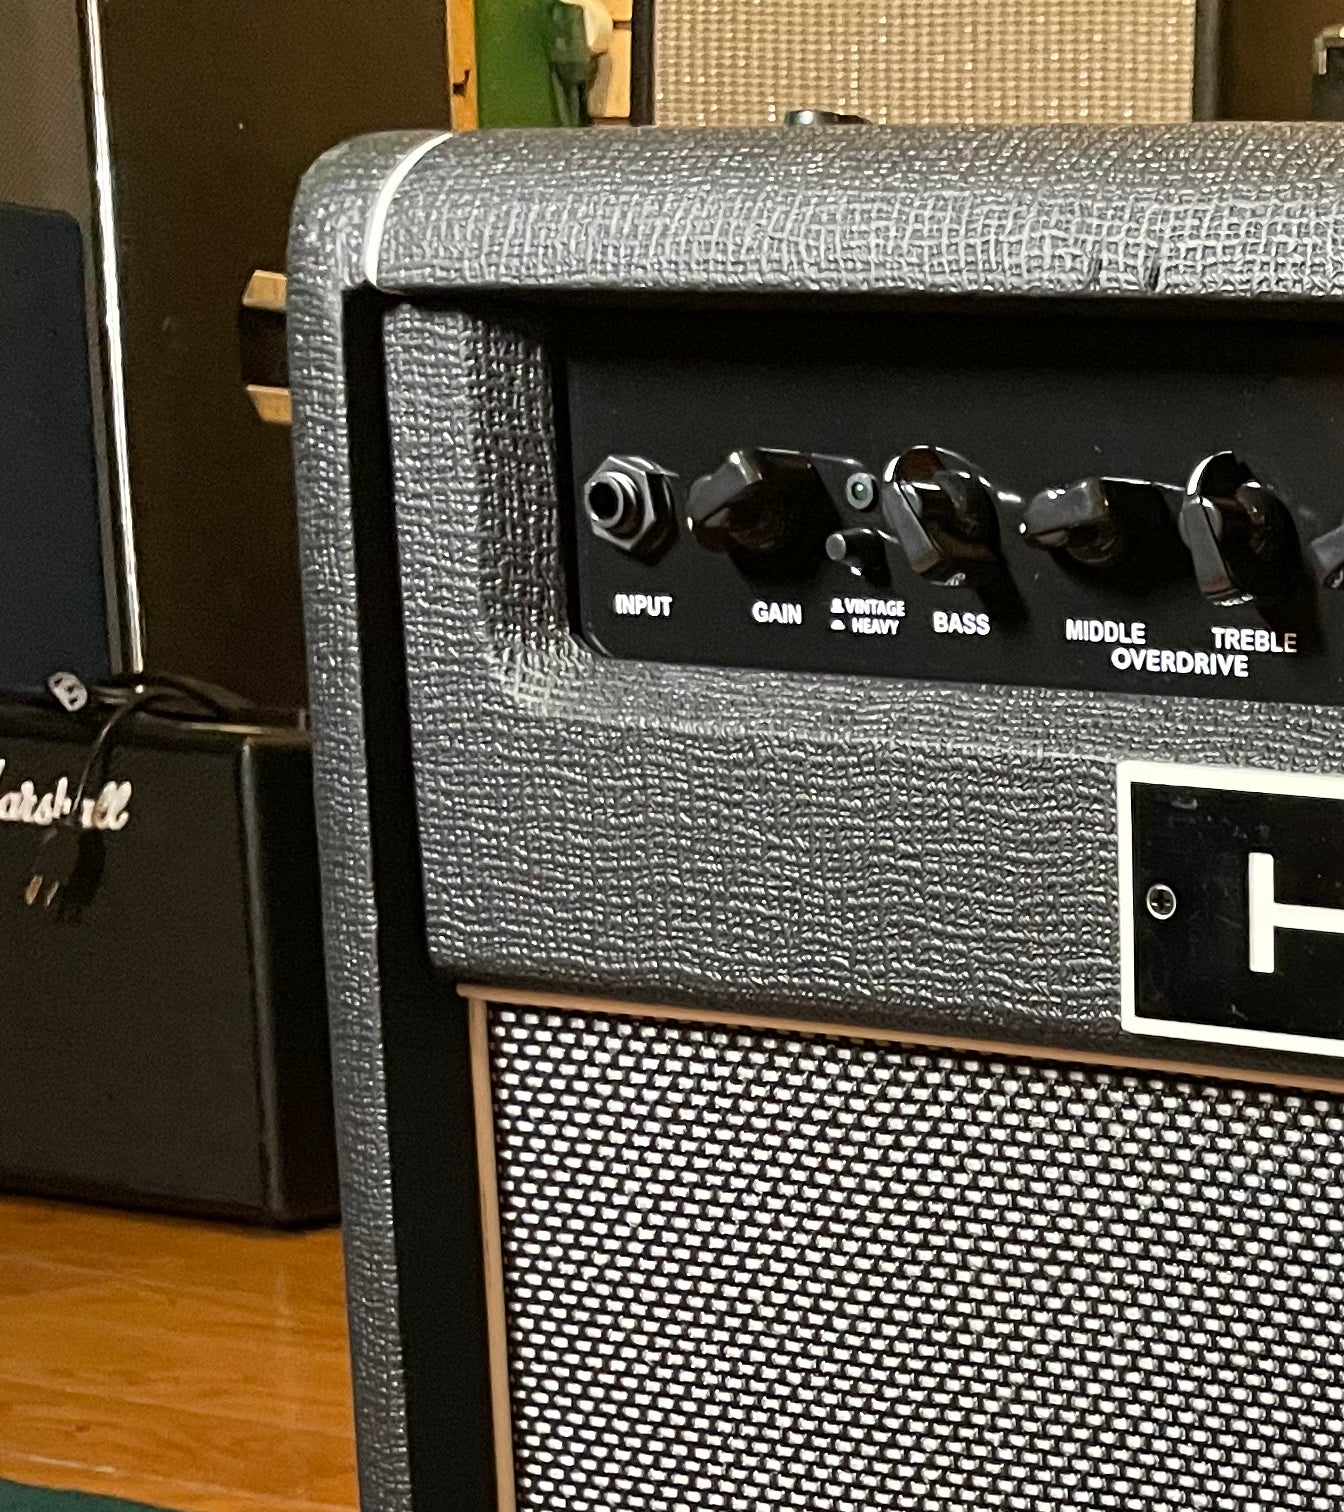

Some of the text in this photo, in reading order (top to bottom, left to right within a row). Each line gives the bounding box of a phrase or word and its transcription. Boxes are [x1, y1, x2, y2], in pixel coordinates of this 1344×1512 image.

[614, 593, 673, 617] INPUT
[751, 600, 803, 625] GAIN
[844, 597, 906, 617] VINTAGE
[851, 617, 900, 636] HEAVY
[932, 610, 991, 636] BASS
[1065, 618, 1298, 654] MIDDLE TREBLE
[1110, 646, 1249, 678] OVERDRIVE
